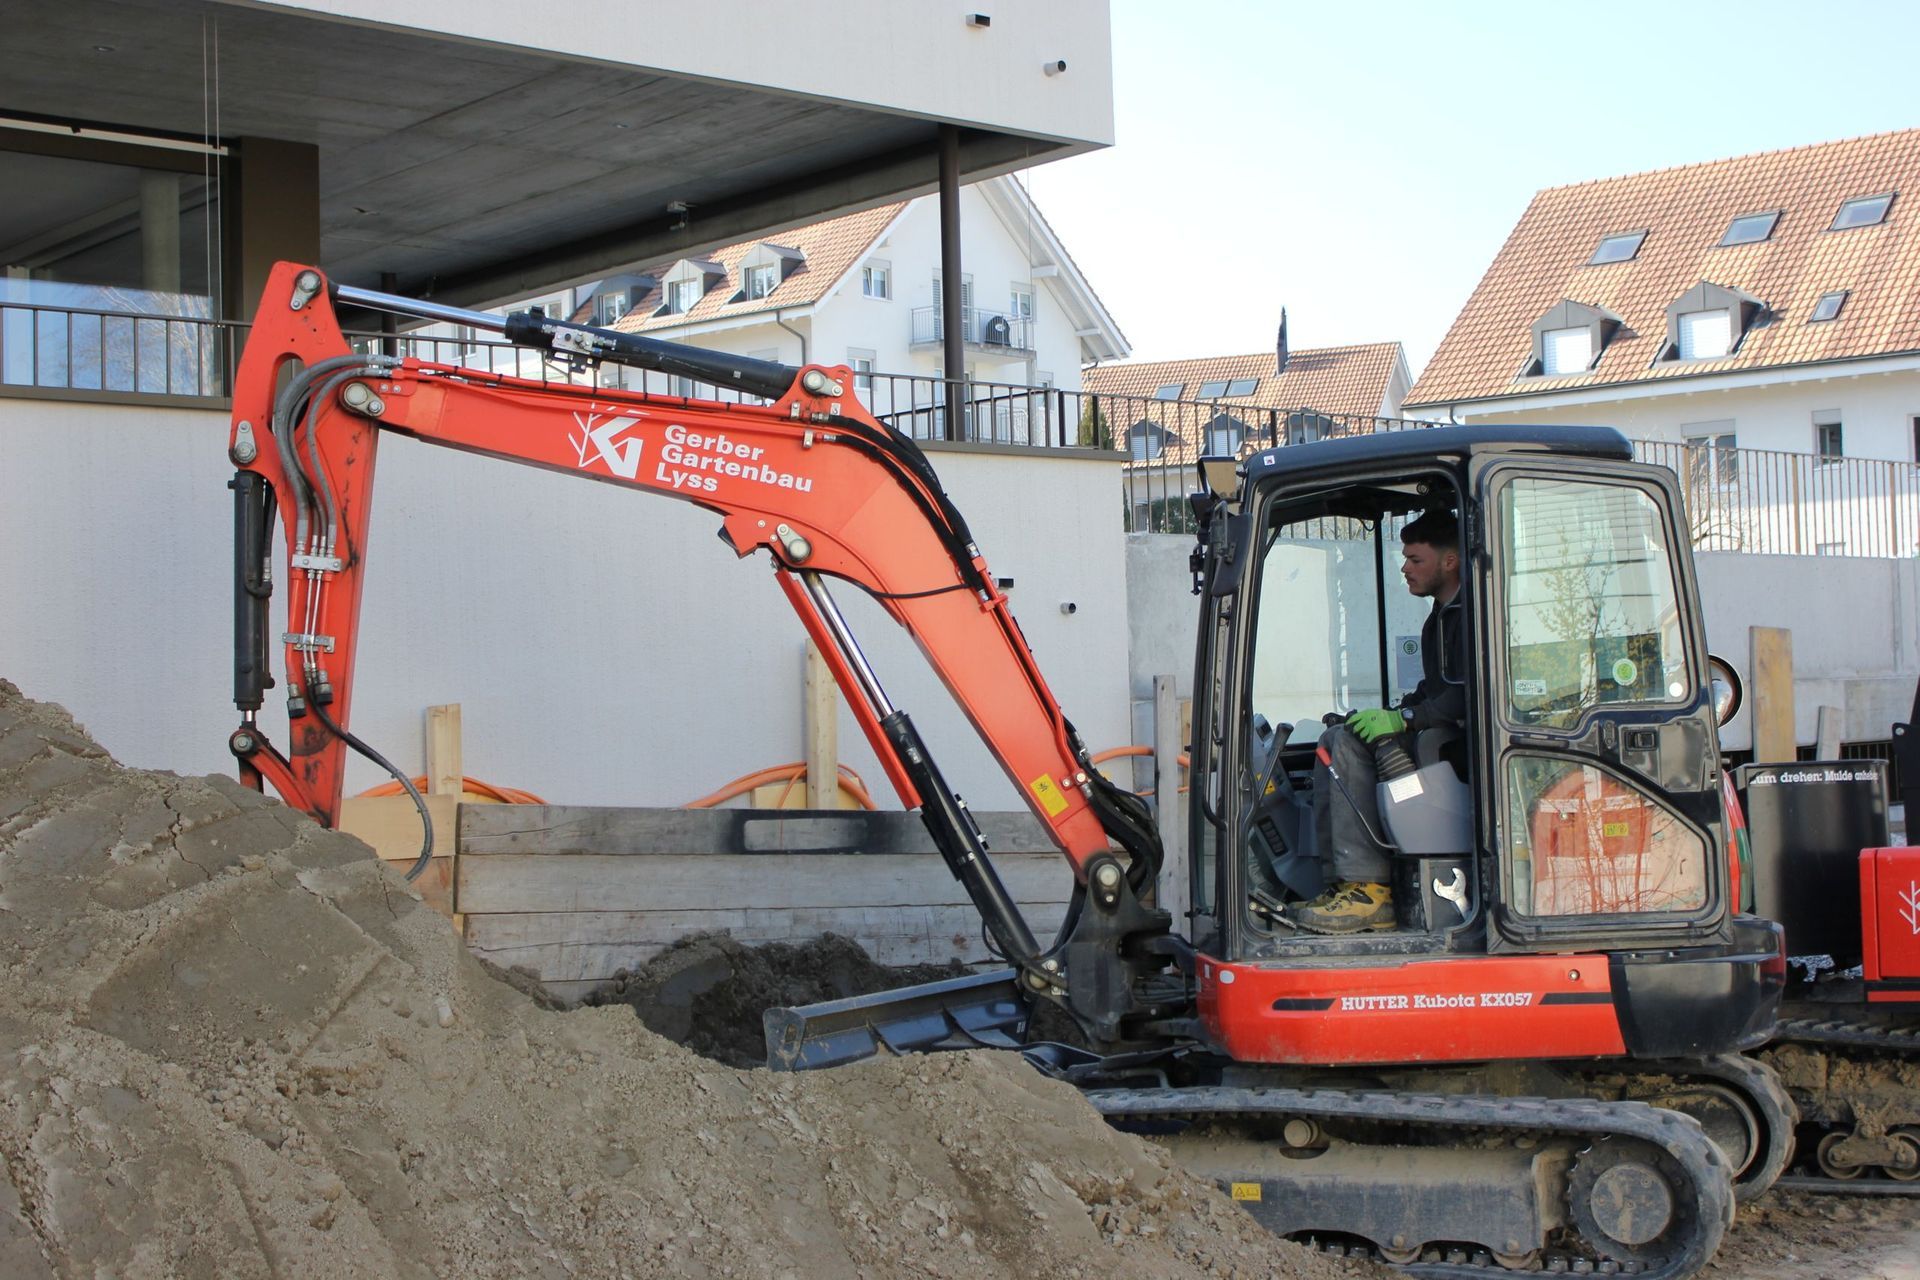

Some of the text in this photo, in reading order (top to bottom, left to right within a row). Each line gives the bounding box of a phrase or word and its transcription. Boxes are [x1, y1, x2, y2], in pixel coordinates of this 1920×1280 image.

[664, 424, 763, 461] Gerber
[656, 462, 718, 491] Lyss
[661, 444, 812, 492] Gartenbau
[1824, 770, 1852, 782] Mulde
[1341, 993, 1532, 1010] HUTTER Kubota KX057
